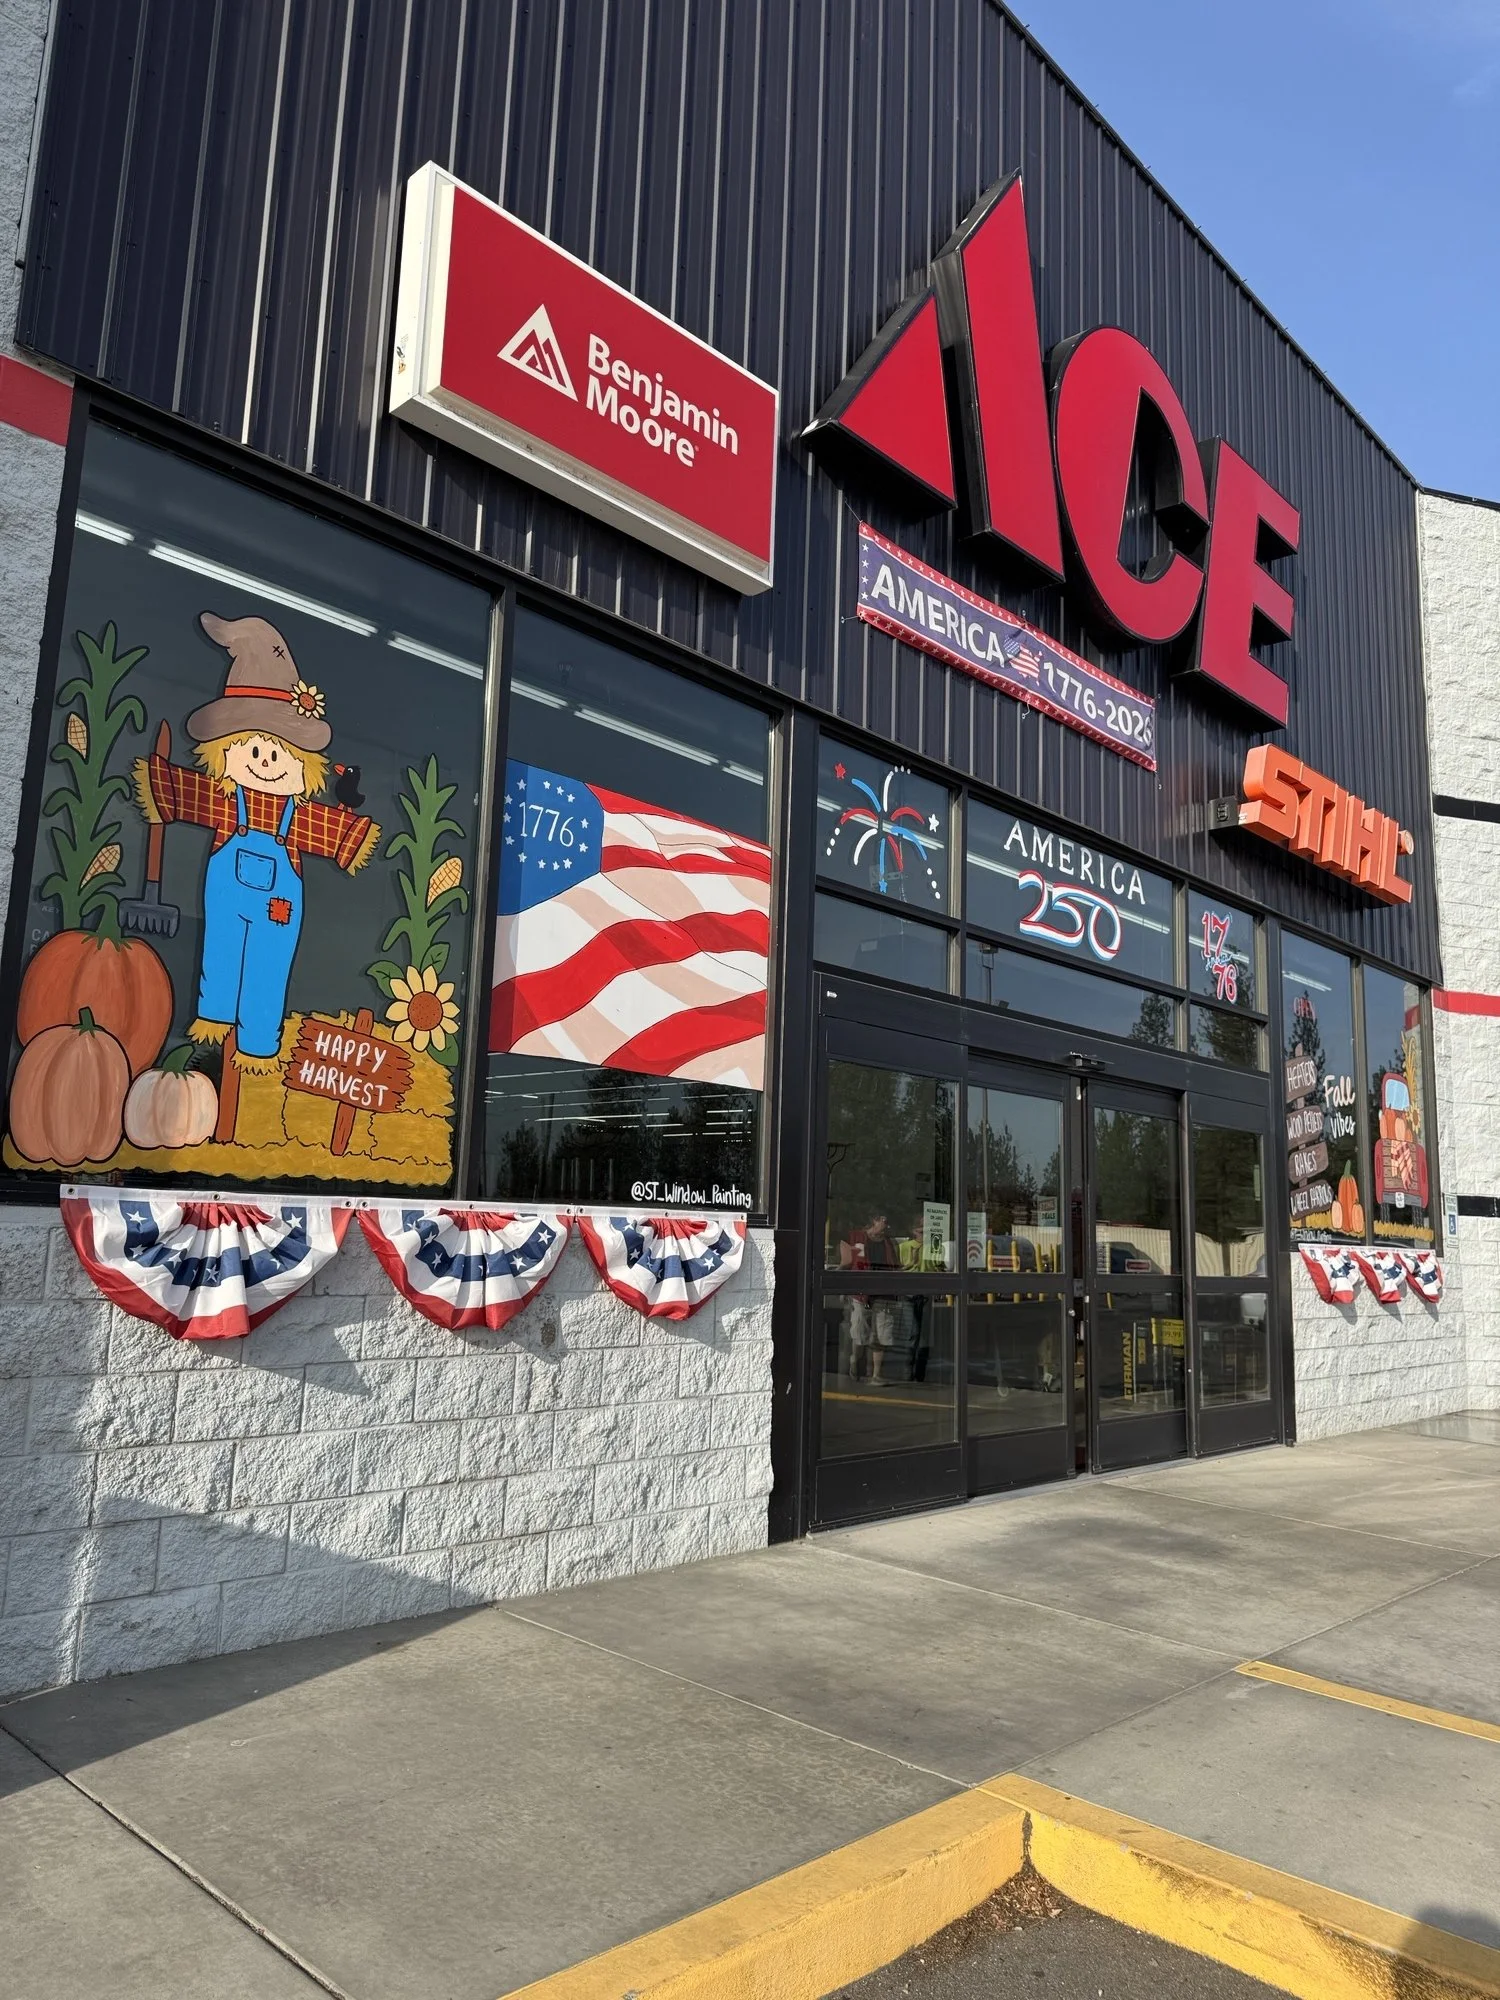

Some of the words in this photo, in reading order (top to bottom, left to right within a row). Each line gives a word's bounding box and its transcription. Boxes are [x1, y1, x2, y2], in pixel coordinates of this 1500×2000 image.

[587, 333, 738, 455] Benjamin
[586, 374, 695, 467] Moore
[838, 174, 1300, 728] ACE
[870, 564, 1005, 668] AMERICA
[519, 802, 574, 847] 1776
[1244, 744, 1412, 904] STIHL
[1003, 819, 1146, 905] AMERICA
[1018, 868, 1121, 961] 250
[1202, 911, 1231, 960] 17
[1212, 963, 1237, 1004] 76
[315, 1030, 387, 1074] HAPPY
[1286, 1060, 1316, 1092] HEATERS
[299, 1059, 389, 1107] HARVEST
[1322, 1074, 1355, 1108] Fall
[1330, 1113, 1356, 1139] vibes
[1294, 1150, 1317, 1177] RAKES
